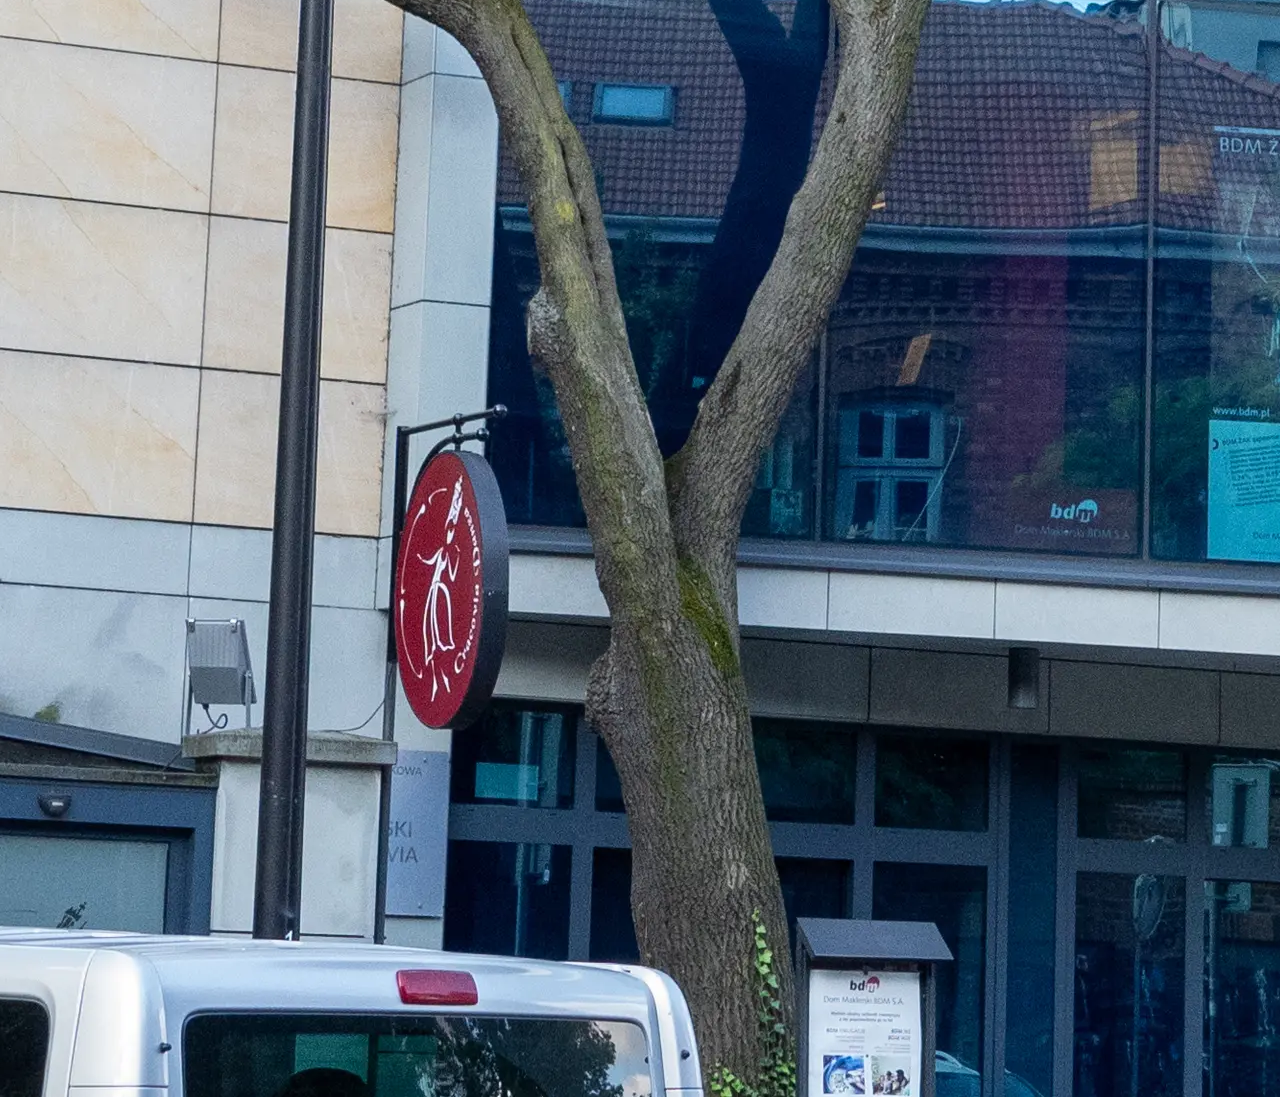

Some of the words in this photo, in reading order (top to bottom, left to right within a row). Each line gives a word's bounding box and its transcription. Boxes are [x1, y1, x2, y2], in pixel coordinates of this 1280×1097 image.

[1219, 137, 1262, 154] BDM
[1212, 407, 1270, 420] www.bdm.pl
[823, 995, 841, 1003] Dom
